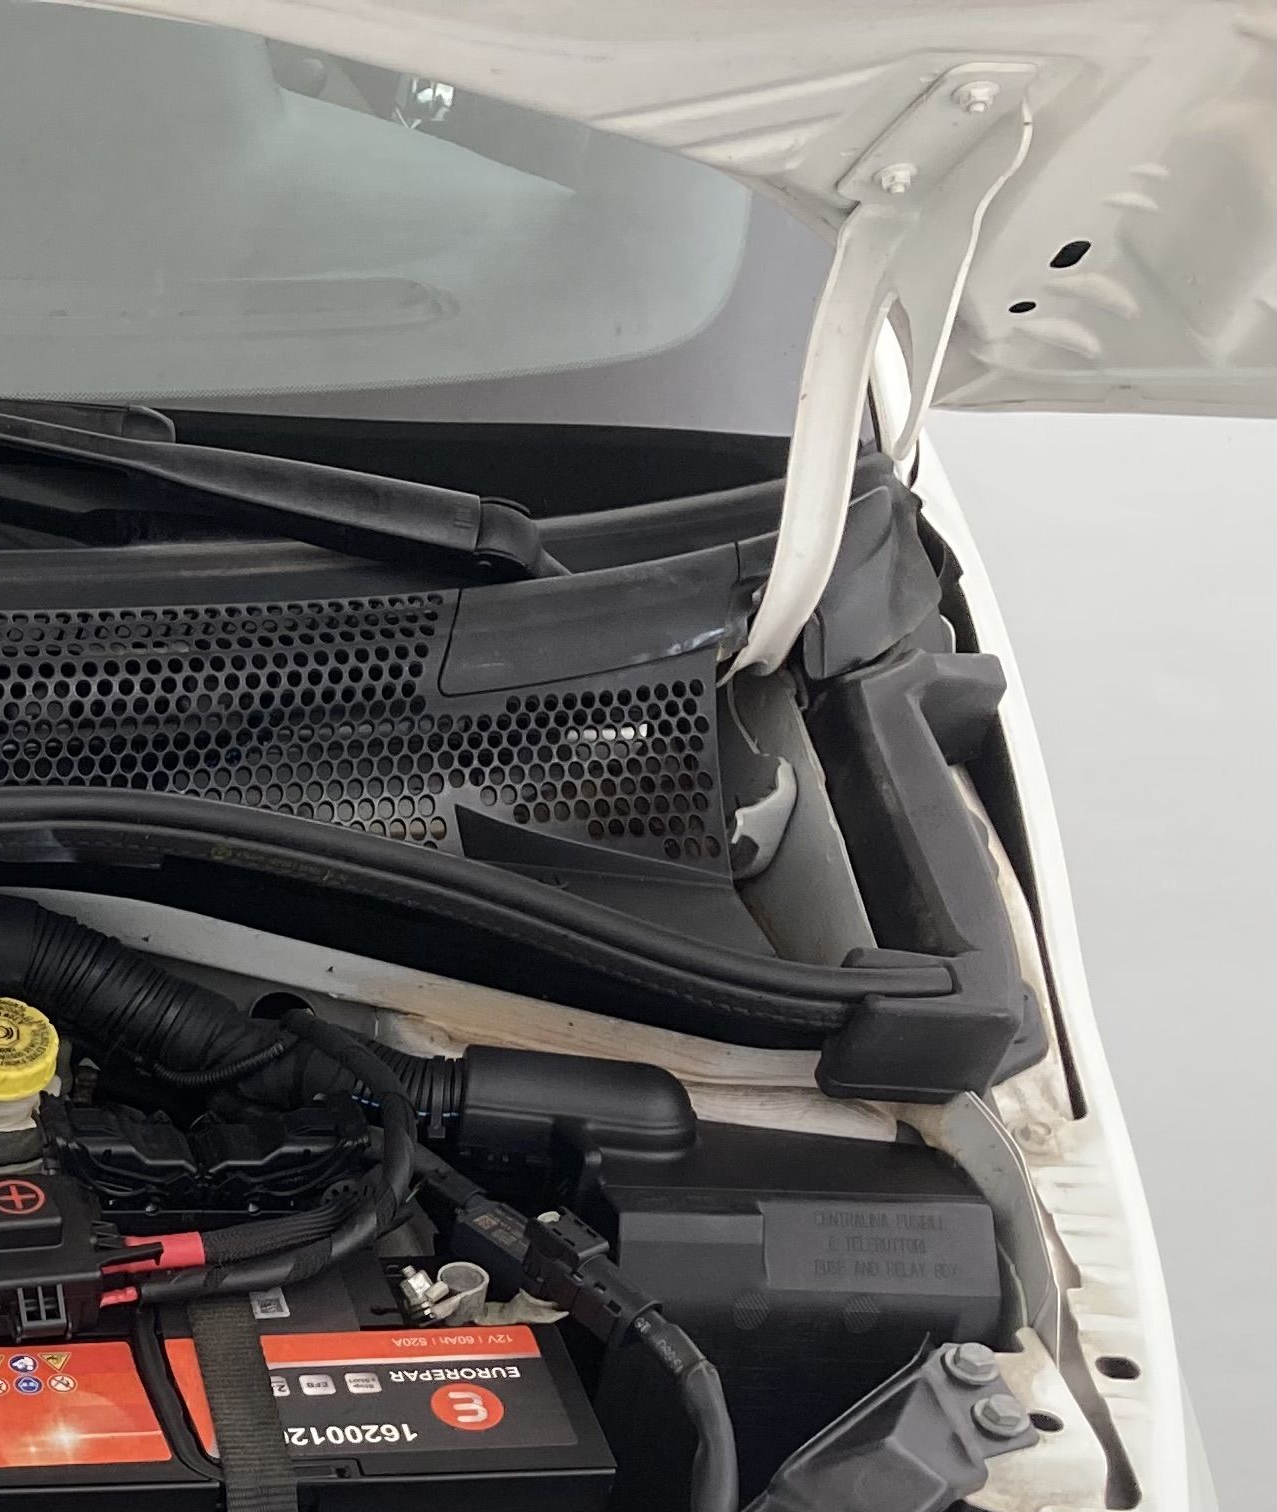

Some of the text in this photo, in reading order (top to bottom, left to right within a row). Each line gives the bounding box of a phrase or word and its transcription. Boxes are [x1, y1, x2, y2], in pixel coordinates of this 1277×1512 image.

[814, 1260, 958, 1279] FUSE AND RELAY BOX
[391, 1334, 513, 1347] 12V 60Ah 520A
[389, 1366, 521, 1382] EUROREPAR
